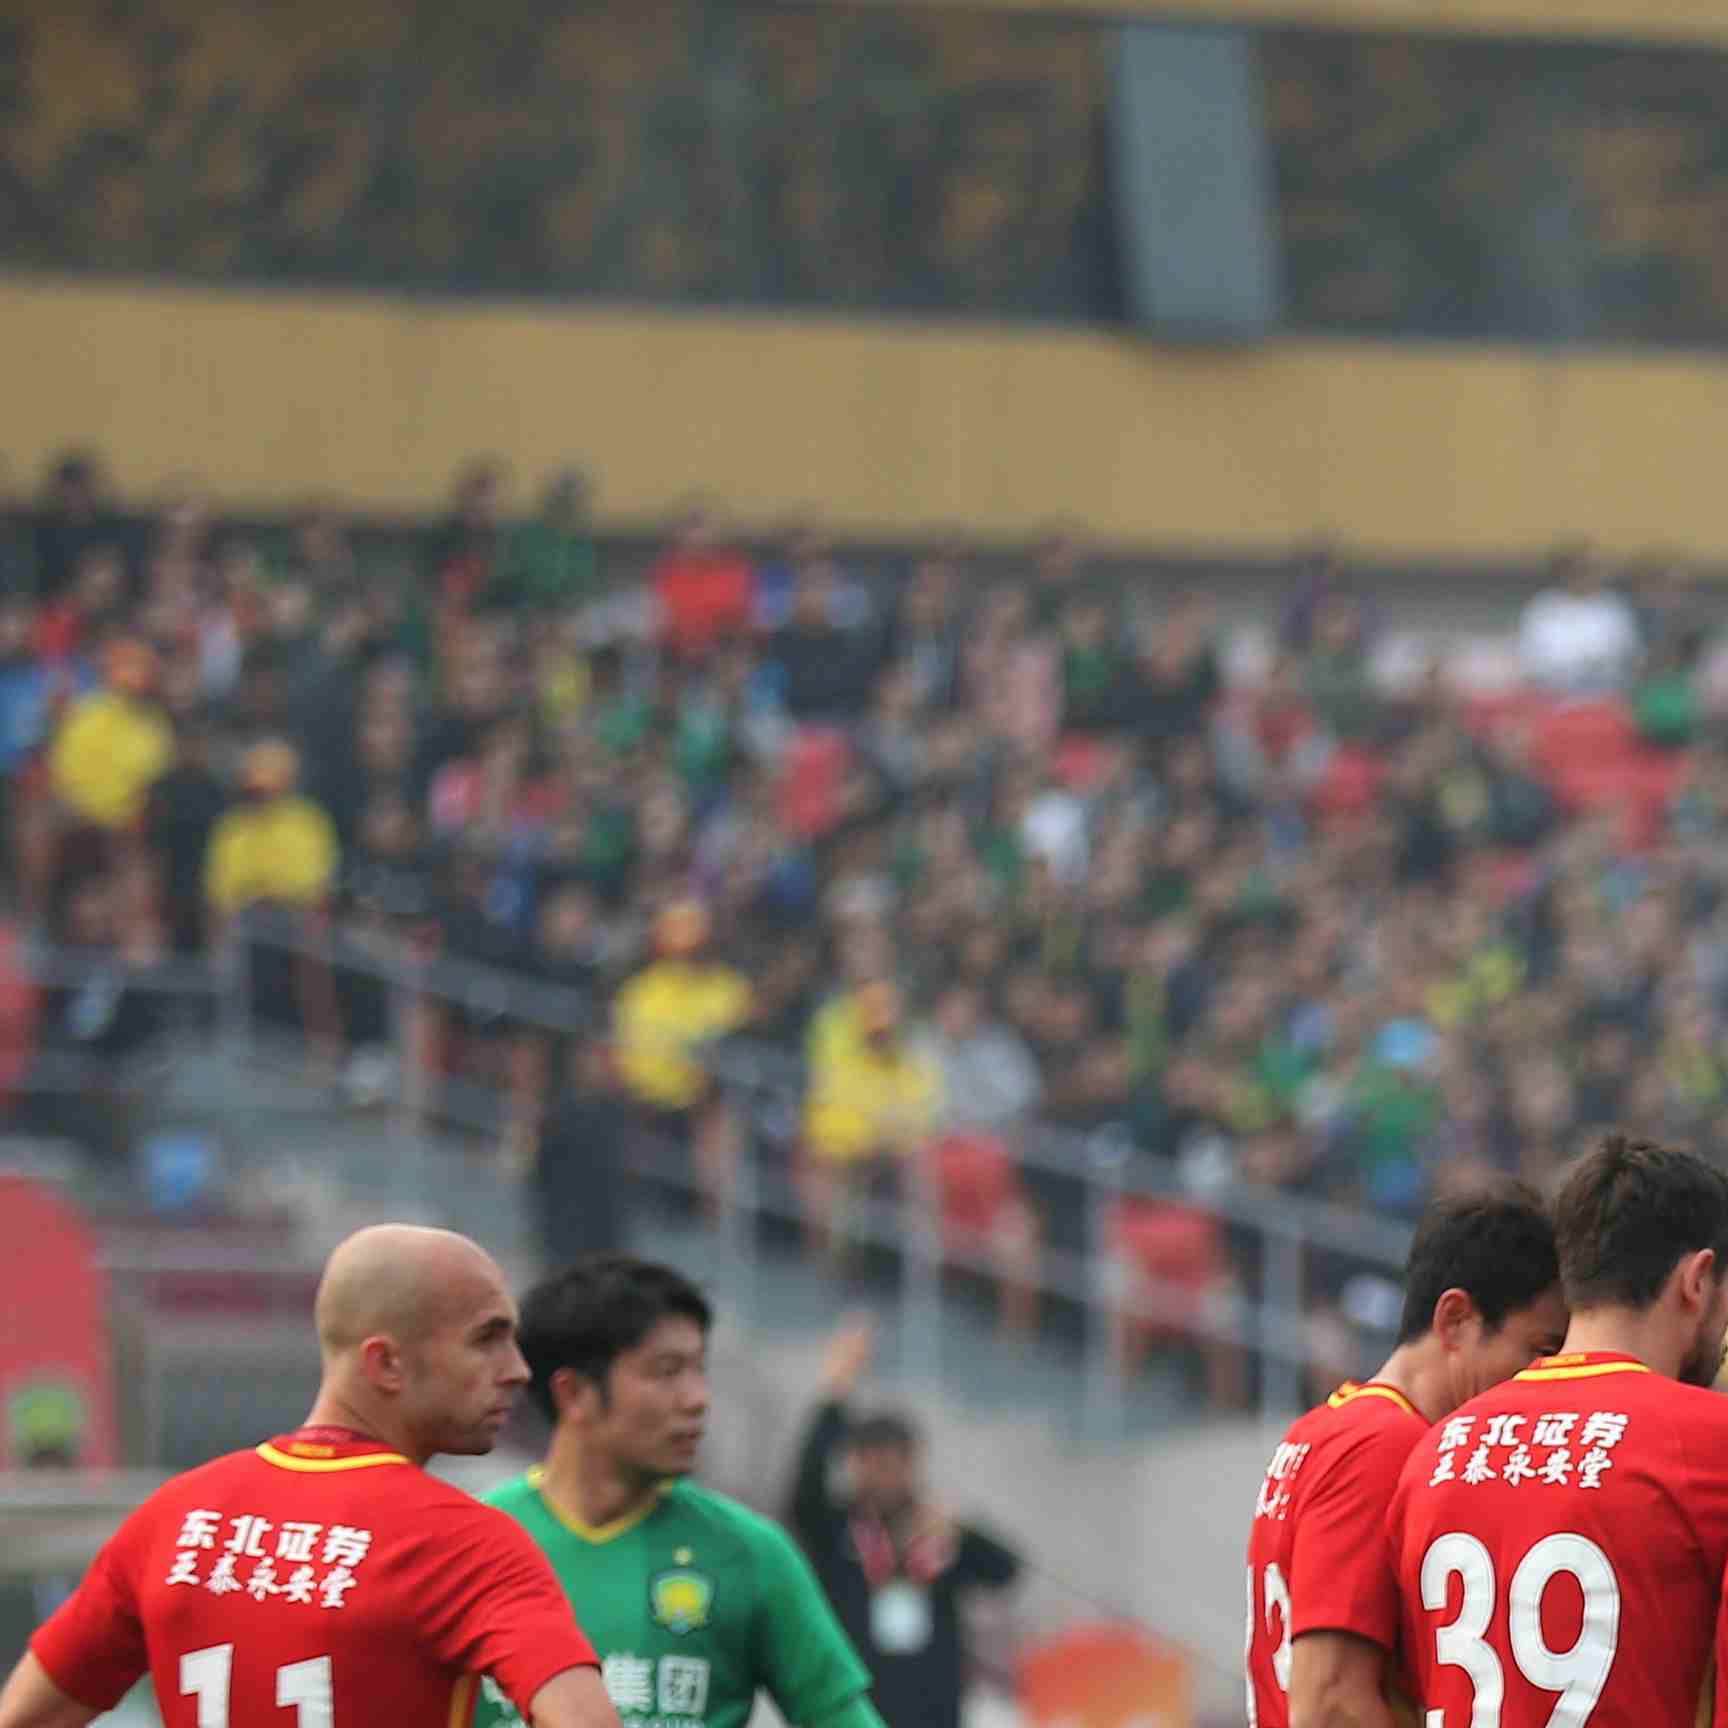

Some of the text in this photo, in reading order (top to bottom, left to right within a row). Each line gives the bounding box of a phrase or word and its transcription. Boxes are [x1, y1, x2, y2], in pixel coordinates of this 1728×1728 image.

[1437, 1411, 1629, 1453] 东北证券
[175, 1508, 373, 1567] 东北证券
